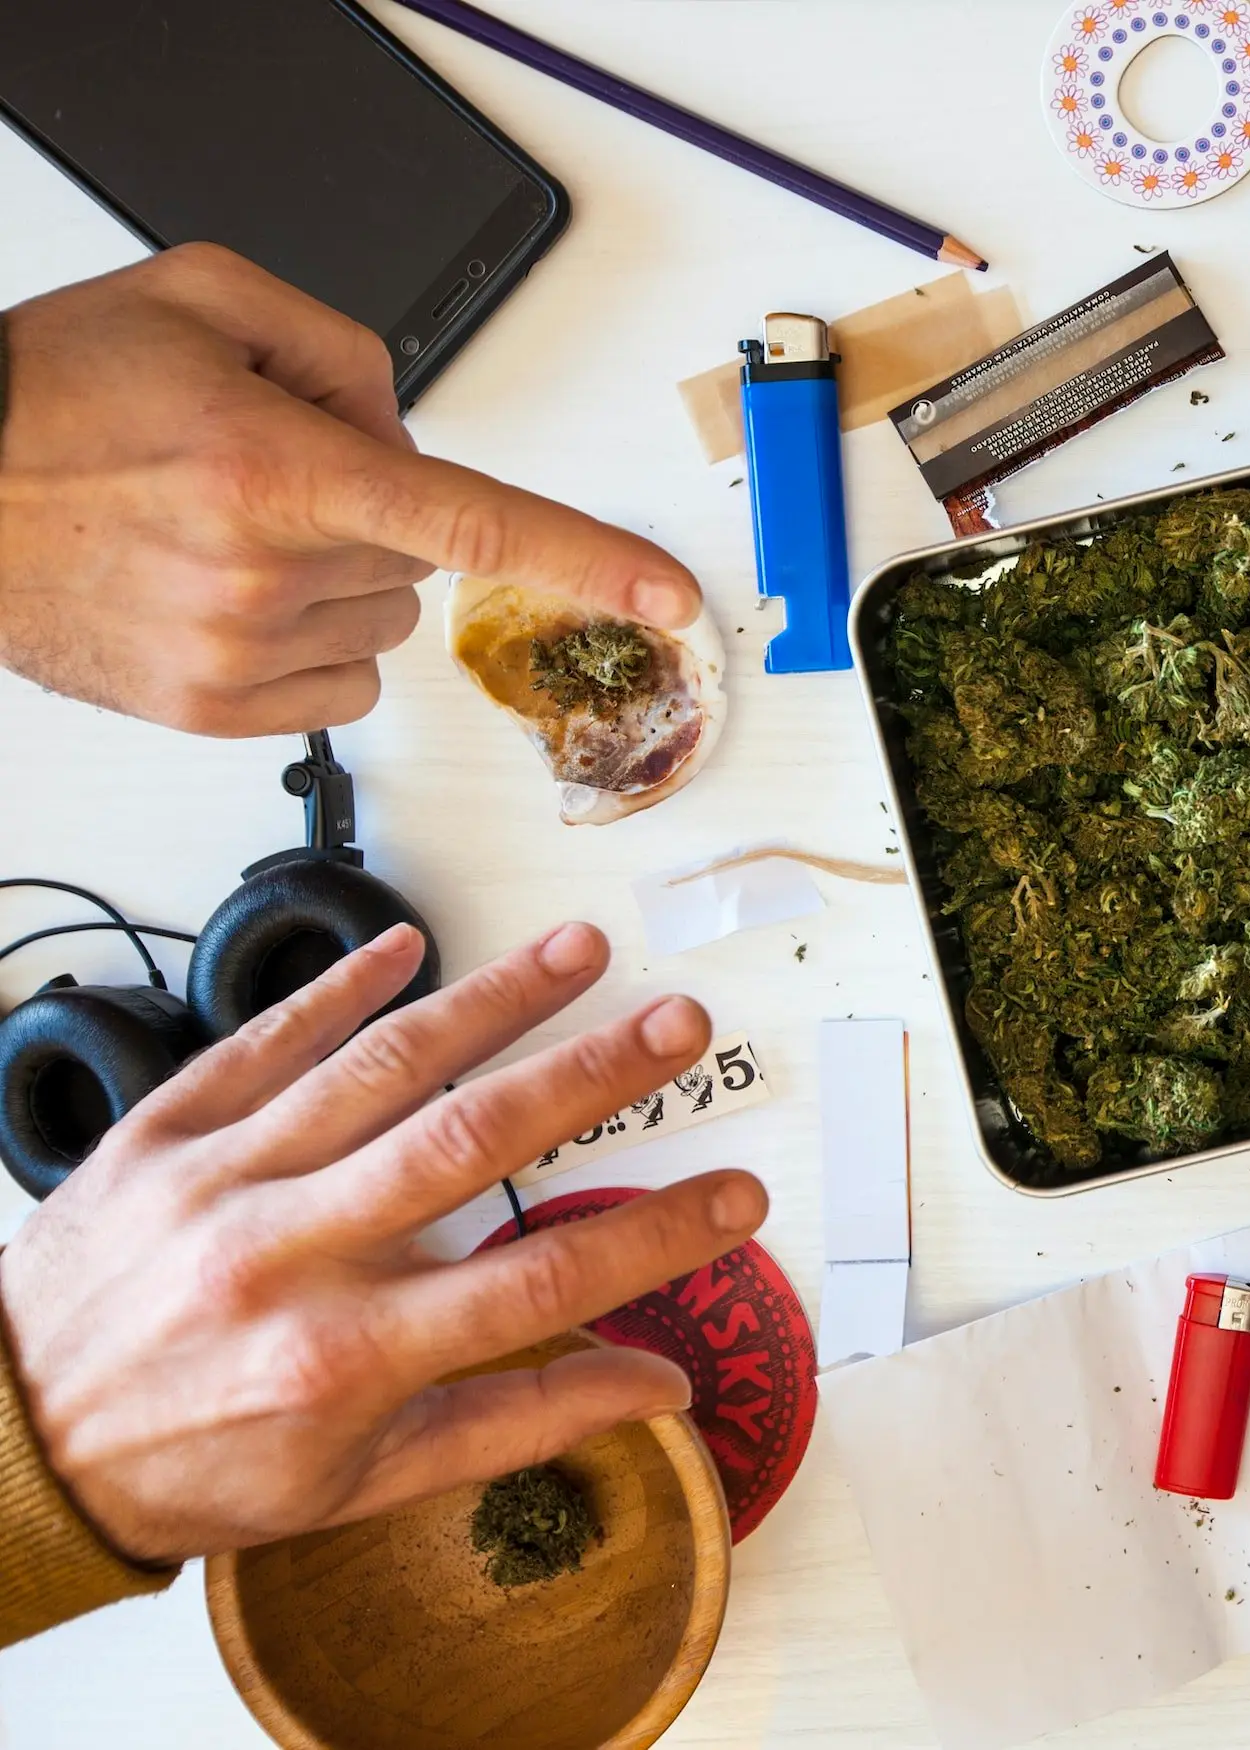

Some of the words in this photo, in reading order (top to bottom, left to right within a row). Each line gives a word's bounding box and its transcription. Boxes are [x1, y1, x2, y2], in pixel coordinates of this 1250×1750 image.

[1084, 289, 1110, 308] GOMA
[1047, 305, 1084, 330] NATURAL
[1011, 326, 1047, 351] VEGETAL
[1134, 339, 1159, 358] PAPEL
[992, 347, 1011, 361] SEM
[1121, 354, 1134, 365] DE
[1124, 353, 1149, 371] PAPEL
[949, 358, 993, 387] CORANTES
[1085, 361, 1122, 386] ENROLAR
[1112, 368, 1124, 378] DE
[1122, 359, 1152, 379] PAPIER
[1053, 372, 1087, 396] MEDIUM
[1092, 375, 1112, 389] LIAR
[1109, 366, 1152, 395] ULTRATHIN
[1033, 392, 1053, 407] SIZE
[1041, 382, 1085, 411] ULTRAFINO
[1048, 386, 1092, 414] ULTRAFINO
[1084, 380, 1115, 402] ROULER
[1057, 391, 1109, 425] UNBLEACHED
[1065, 399, 1084, 413] NON
[1033, 411, 1049, 424] SIN
[968, 418, 1024, 454] BRANQUEADO
[985, 420, 1033, 451] BLANQUEAR
[1004, 430, 1030, 448] ULTRA
[1022, 421, 1058, 445] ROLLING
[989, 444, 1004, 457] FIN
[996, 441, 1022, 460] PAPER
